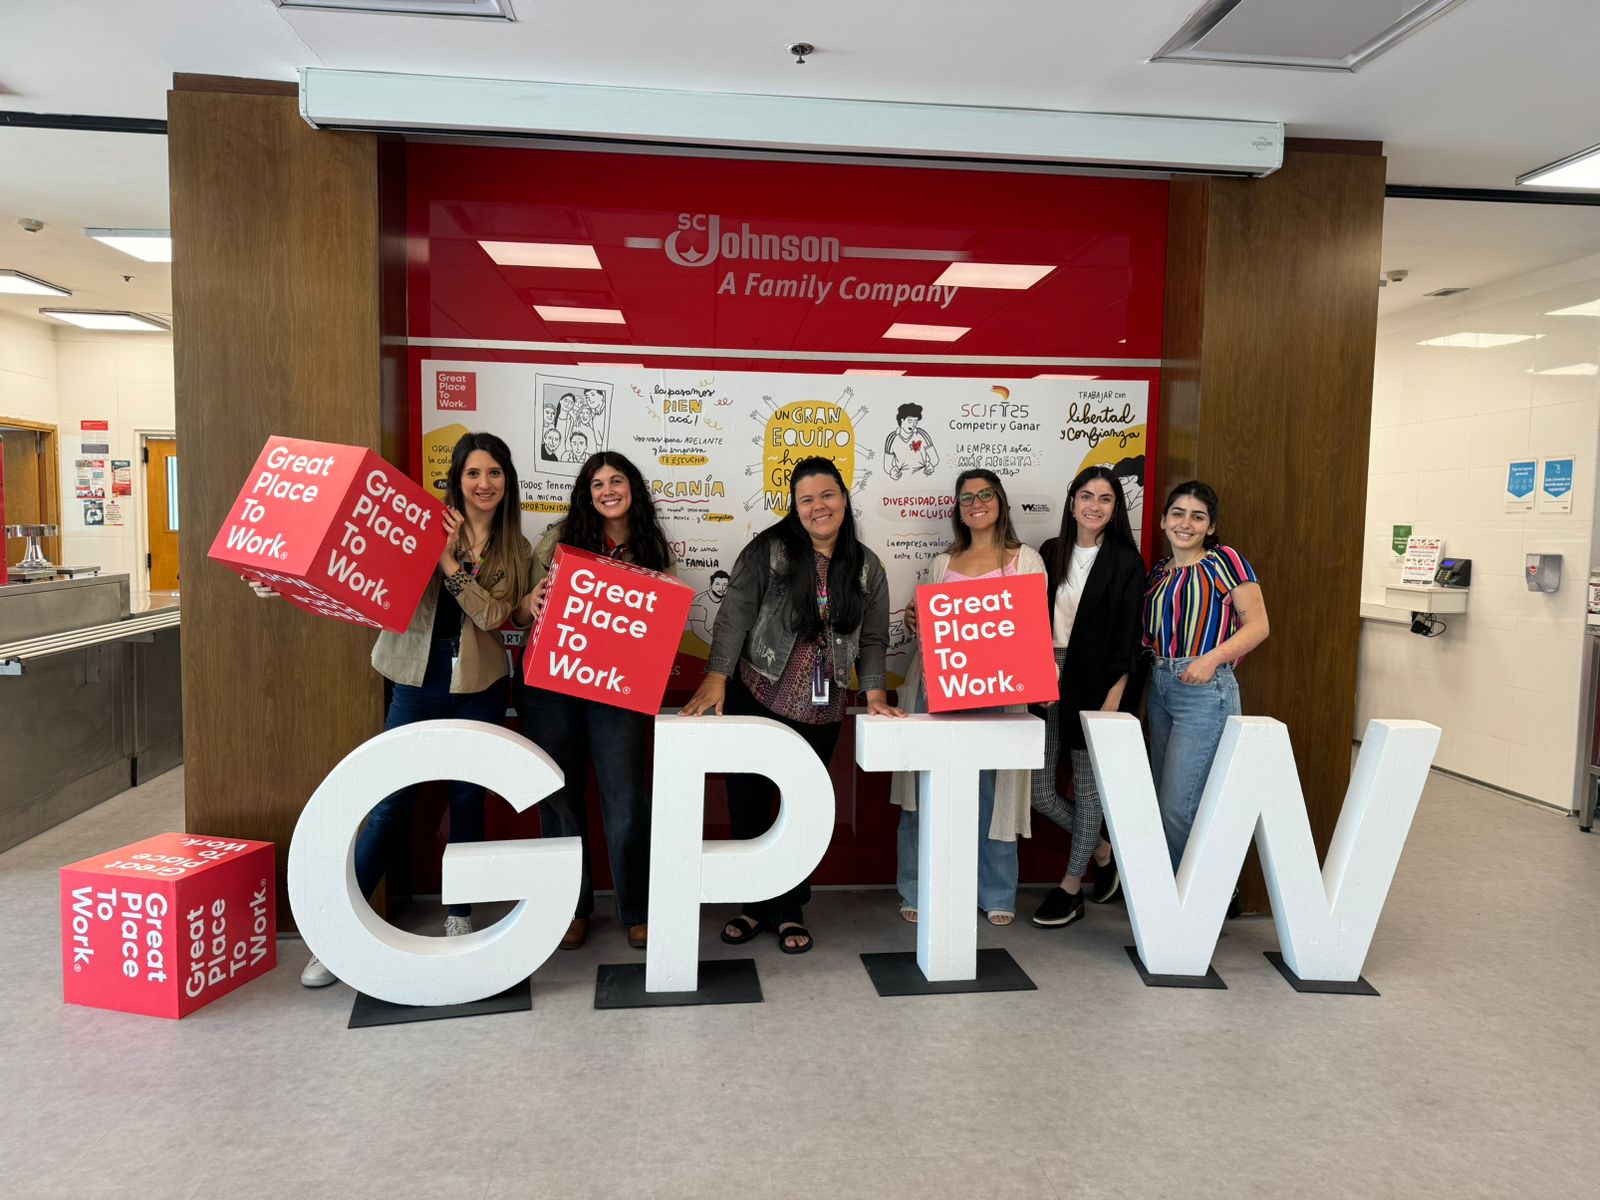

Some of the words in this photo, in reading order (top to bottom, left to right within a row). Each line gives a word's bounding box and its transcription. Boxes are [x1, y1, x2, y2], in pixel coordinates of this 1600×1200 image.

[678, 213, 706, 231] SC
[664, 214, 840, 267] Johnson
[717, 271, 737, 295] A
[744, 274, 833, 305] Family
[838, 276, 959, 309] Company
[438, 373, 466, 383] Great
[439, 382, 466, 391] Place
[439, 391, 450, 399] To
[663, 399, 703, 415] BIEN
[775, 410, 790, 421] UN
[791, 406, 841, 425] GRAN
[1066, 402, 1136, 425] libertad
[949, 419, 998, 432] Competir
[1000, 423, 1006, 433] y
[1009, 420, 1041, 431] Ganar
[1060, 429, 1066, 440] y
[431, 444, 454, 454] ORGU
[684, 436, 724, 446] ADELANTE
[956, 443, 964, 454] LA
[967, 443, 1007, 454] EMPRESA
[267, 446, 335, 476] Great
[661, 456, 669, 464] TE
[671, 456, 706, 466] ESCUCHA
[984, 456, 1032, 468] ABIERTA
[252, 472, 319, 503] Place
[525, 492, 533, 501] la
[537, 494, 563, 502] misma
[240, 498, 266, 523] To
[366, 469, 432, 531] Great
[520, 502, 571, 513] OPORTUNIDA
[909, 506, 954, 519] INCLUSIÓ
[351, 494, 417, 555] Place
[340, 520, 367, 555] To
[896, 541, 928, 550] empresa
[894, 552, 911, 560] entre
[570, 569, 658, 613] Great
[929, 589, 1014, 617] Great
[562, 595, 648, 638] Place
[556, 623, 588, 652] To
[934, 619, 1016, 644] Place
[934, 648, 968, 670] To
[104, 860, 186, 877] Great
[131, 853, 211, 869] Place
[97, 888, 117, 921] To
[121, 891, 143, 978] Place
[145, 892, 168, 983] Great
[207, 898, 226, 986] Place
[185, 905, 206, 998] Great
[229, 940, 247, 978] To
